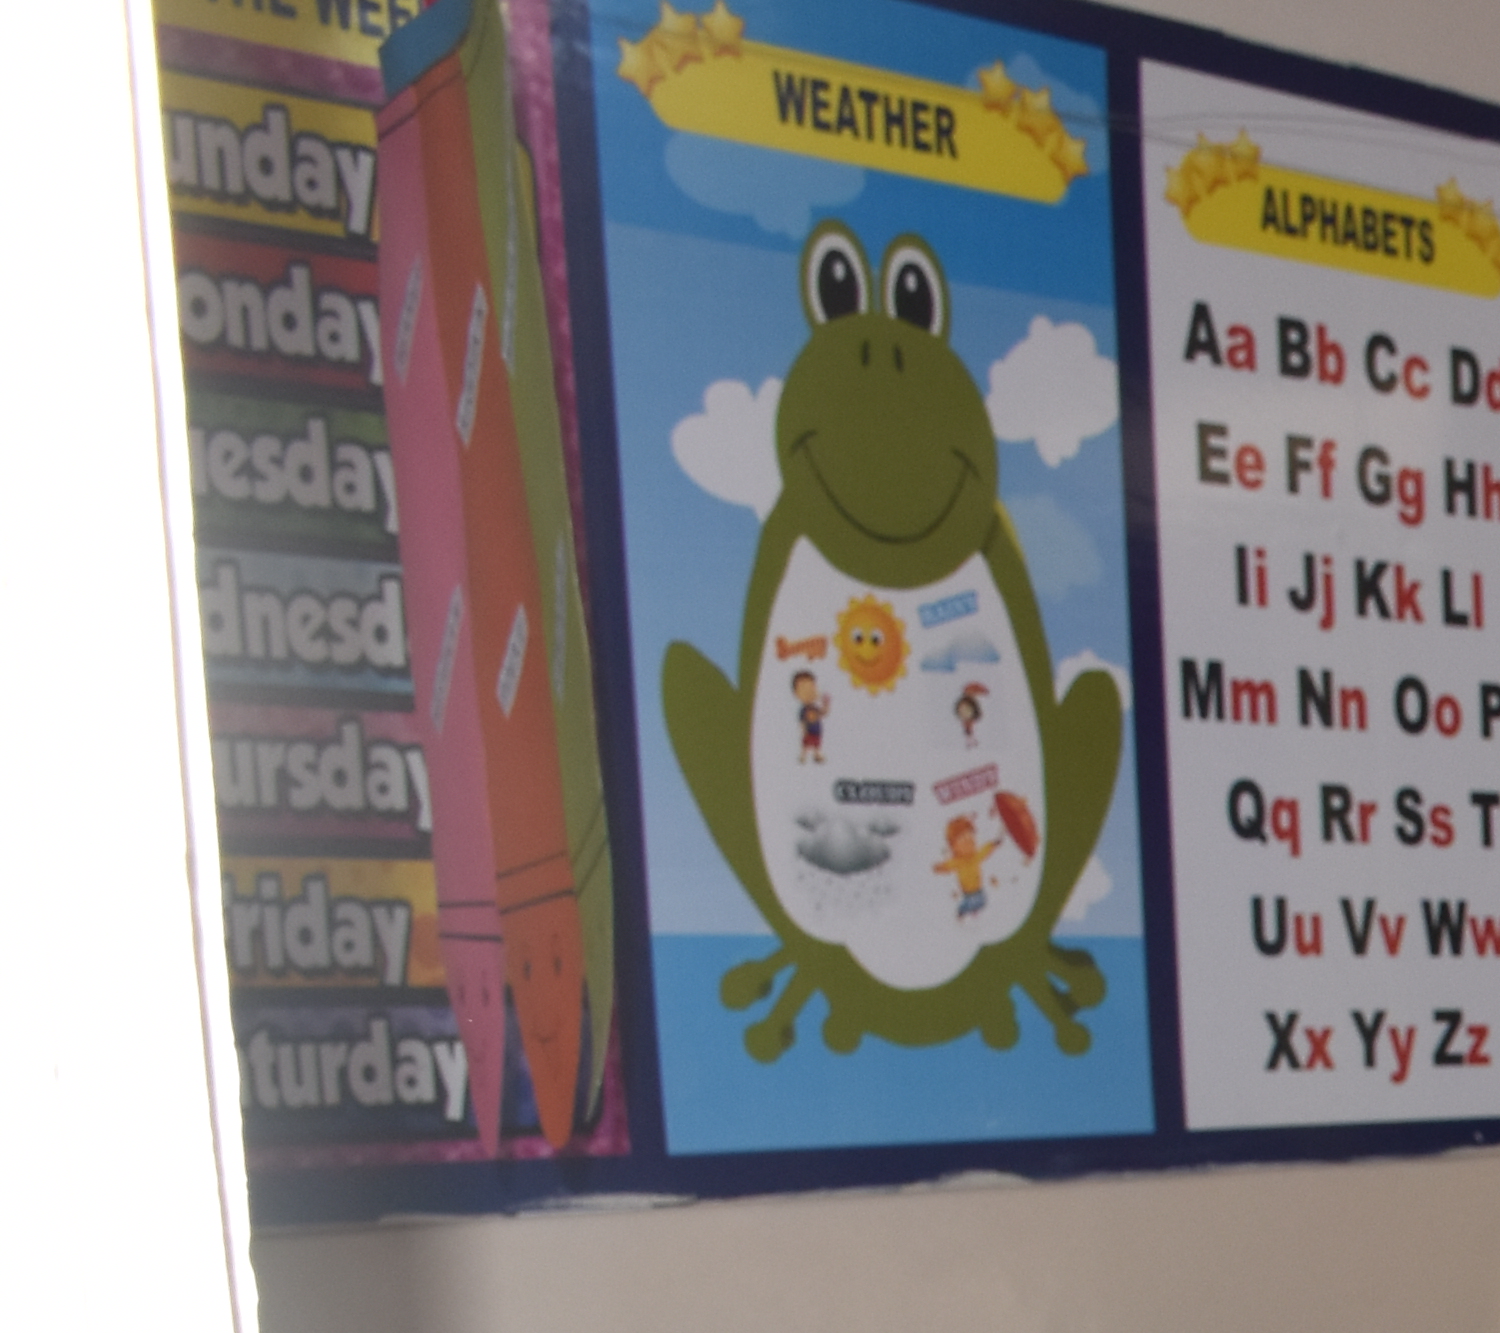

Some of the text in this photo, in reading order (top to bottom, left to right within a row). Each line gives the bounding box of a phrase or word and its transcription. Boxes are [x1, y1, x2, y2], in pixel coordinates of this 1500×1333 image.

[773, 69, 958, 160] WEATHER
[166, 105, 376, 237] unday
[1261, 186, 1436, 264] ALPHABETS
[178, 263, 385, 386] onday
[1183, 300, 1257, 373] Aa
[1277, 314, 1345, 385] Bb
[1365, 332, 1430, 399] Cc
[192, 416, 399, 535] esday
[1196, 420, 1266, 490] Ee
[1287, 433, 1337, 500] Ff
[1358, 446, 1425, 527] Gg
[199, 562, 406, 677] dnesd
[1236, 545, 1484, 630] Ii Jj Kk Ll
[1181, 657, 1279, 726] Mm
[1298, 666, 1368, 732] Nn
[1394, 676, 1463, 738] Oo
[214, 718, 432, 834] ursday
[1228, 778, 1300, 858] Qq
[1321, 783, 1377, 844] Rr
[1395, 787, 1454, 848] Ss
[223, 870, 413, 986] riday
[1251, 895, 1322, 958] Uu
[1340, 897, 1405, 957] Vv
[237, 1014, 468, 1123] turday
[1265, 1009, 1490, 1085] Xx Yy Zz
